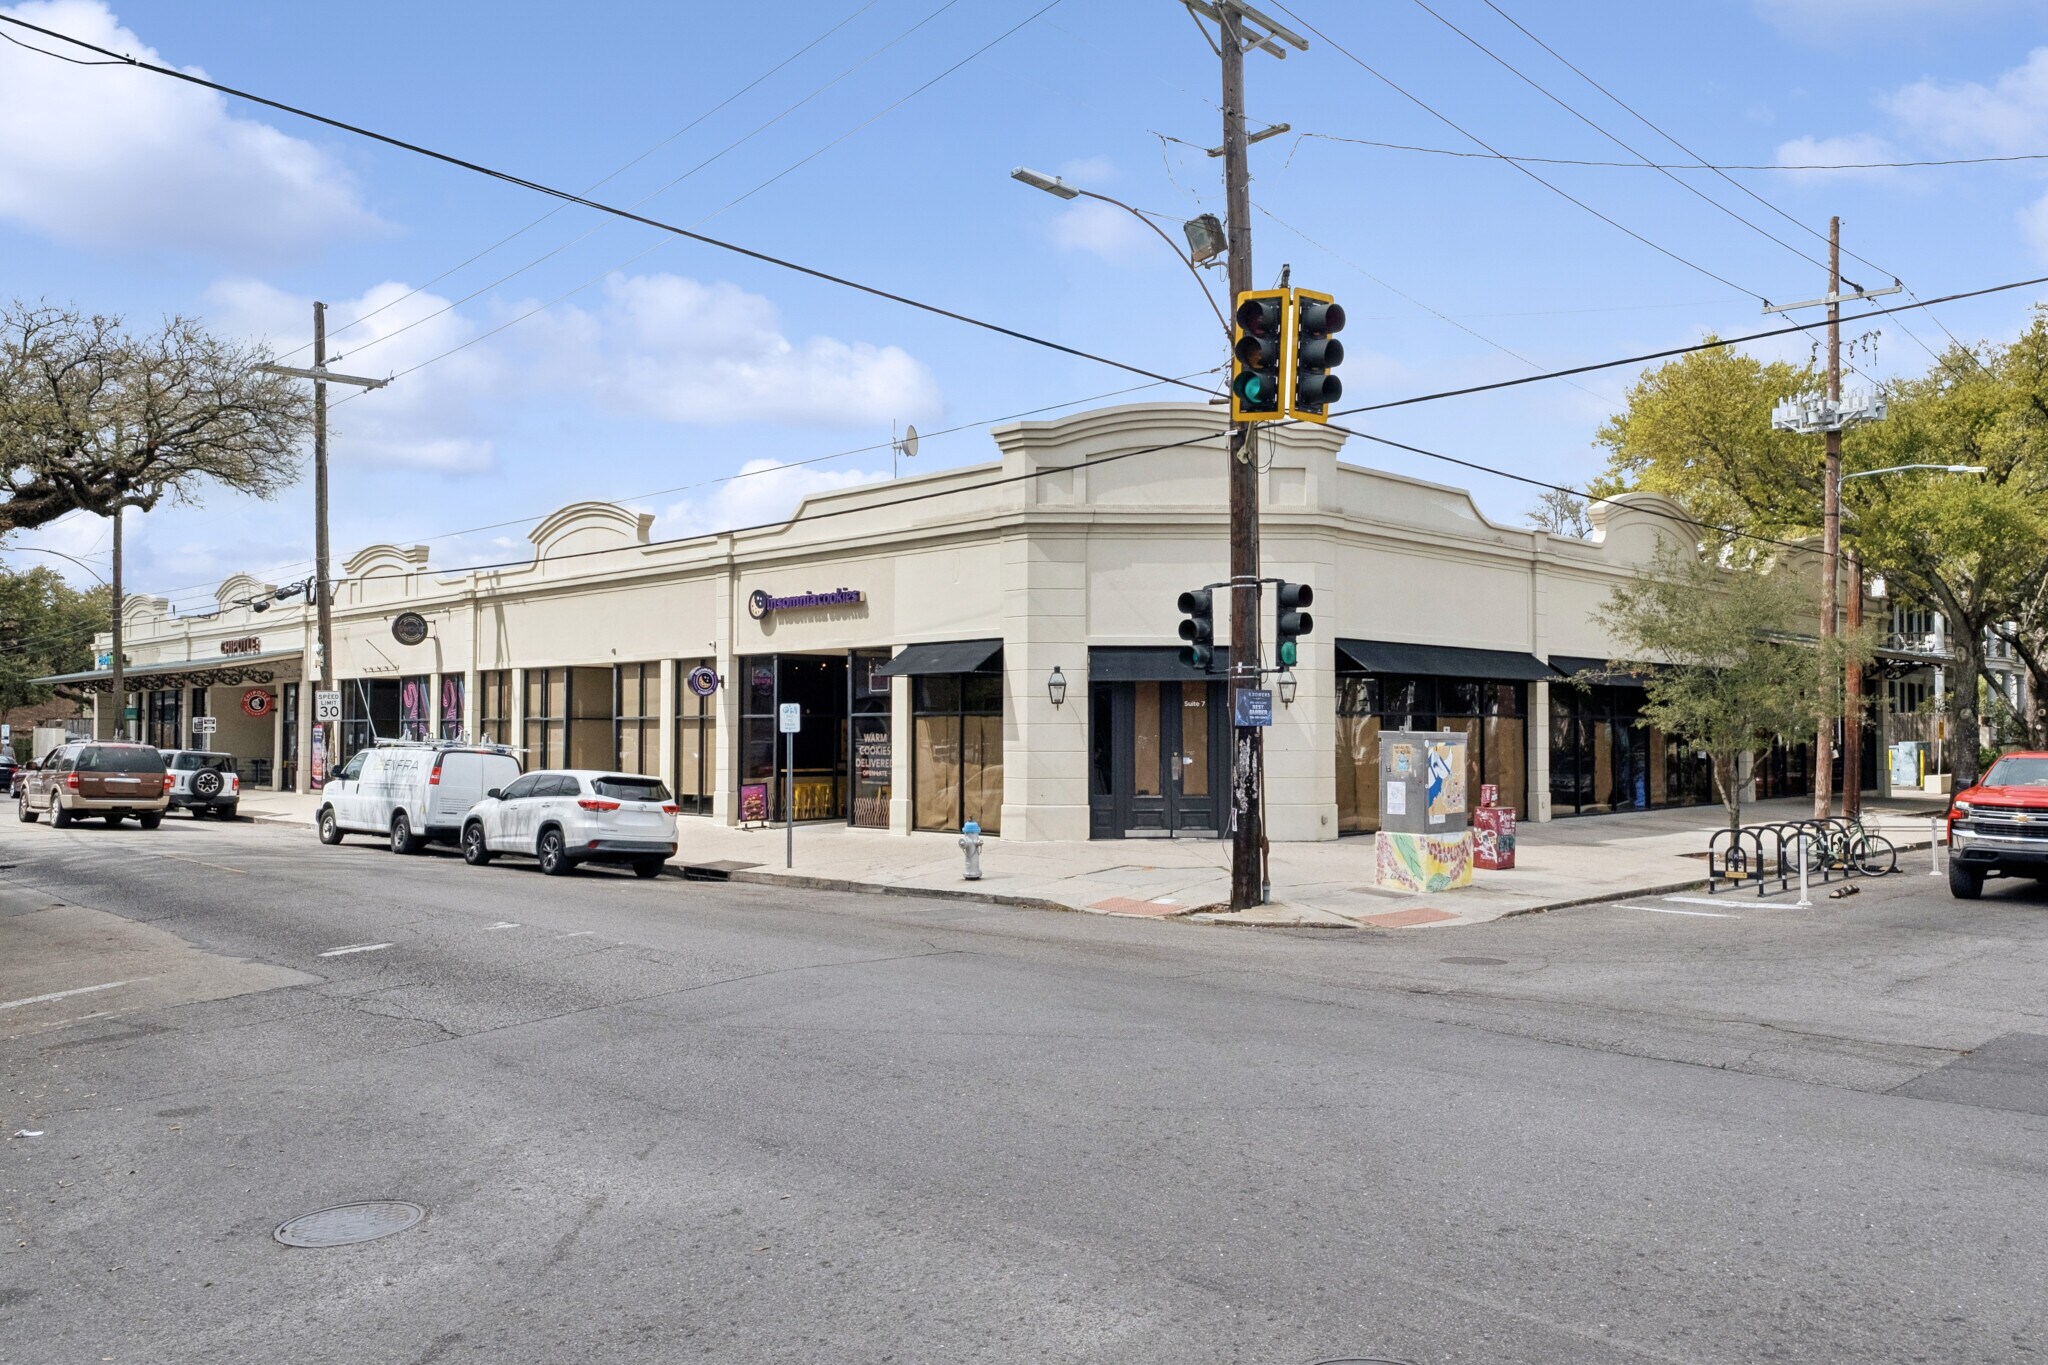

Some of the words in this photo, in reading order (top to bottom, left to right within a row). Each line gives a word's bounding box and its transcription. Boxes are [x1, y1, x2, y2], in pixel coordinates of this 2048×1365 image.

[767, 590, 818, 610] insomnia
[818, 587, 861, 605] cookies
[221, 637, 261, 654] CHIPOTLE
[320, 706, 338, 717] 30
[863, 733, 887, 742] WARM
[860, 745, 891, 755] COOKIES
[384, 759, 418, 771] ENFRA
